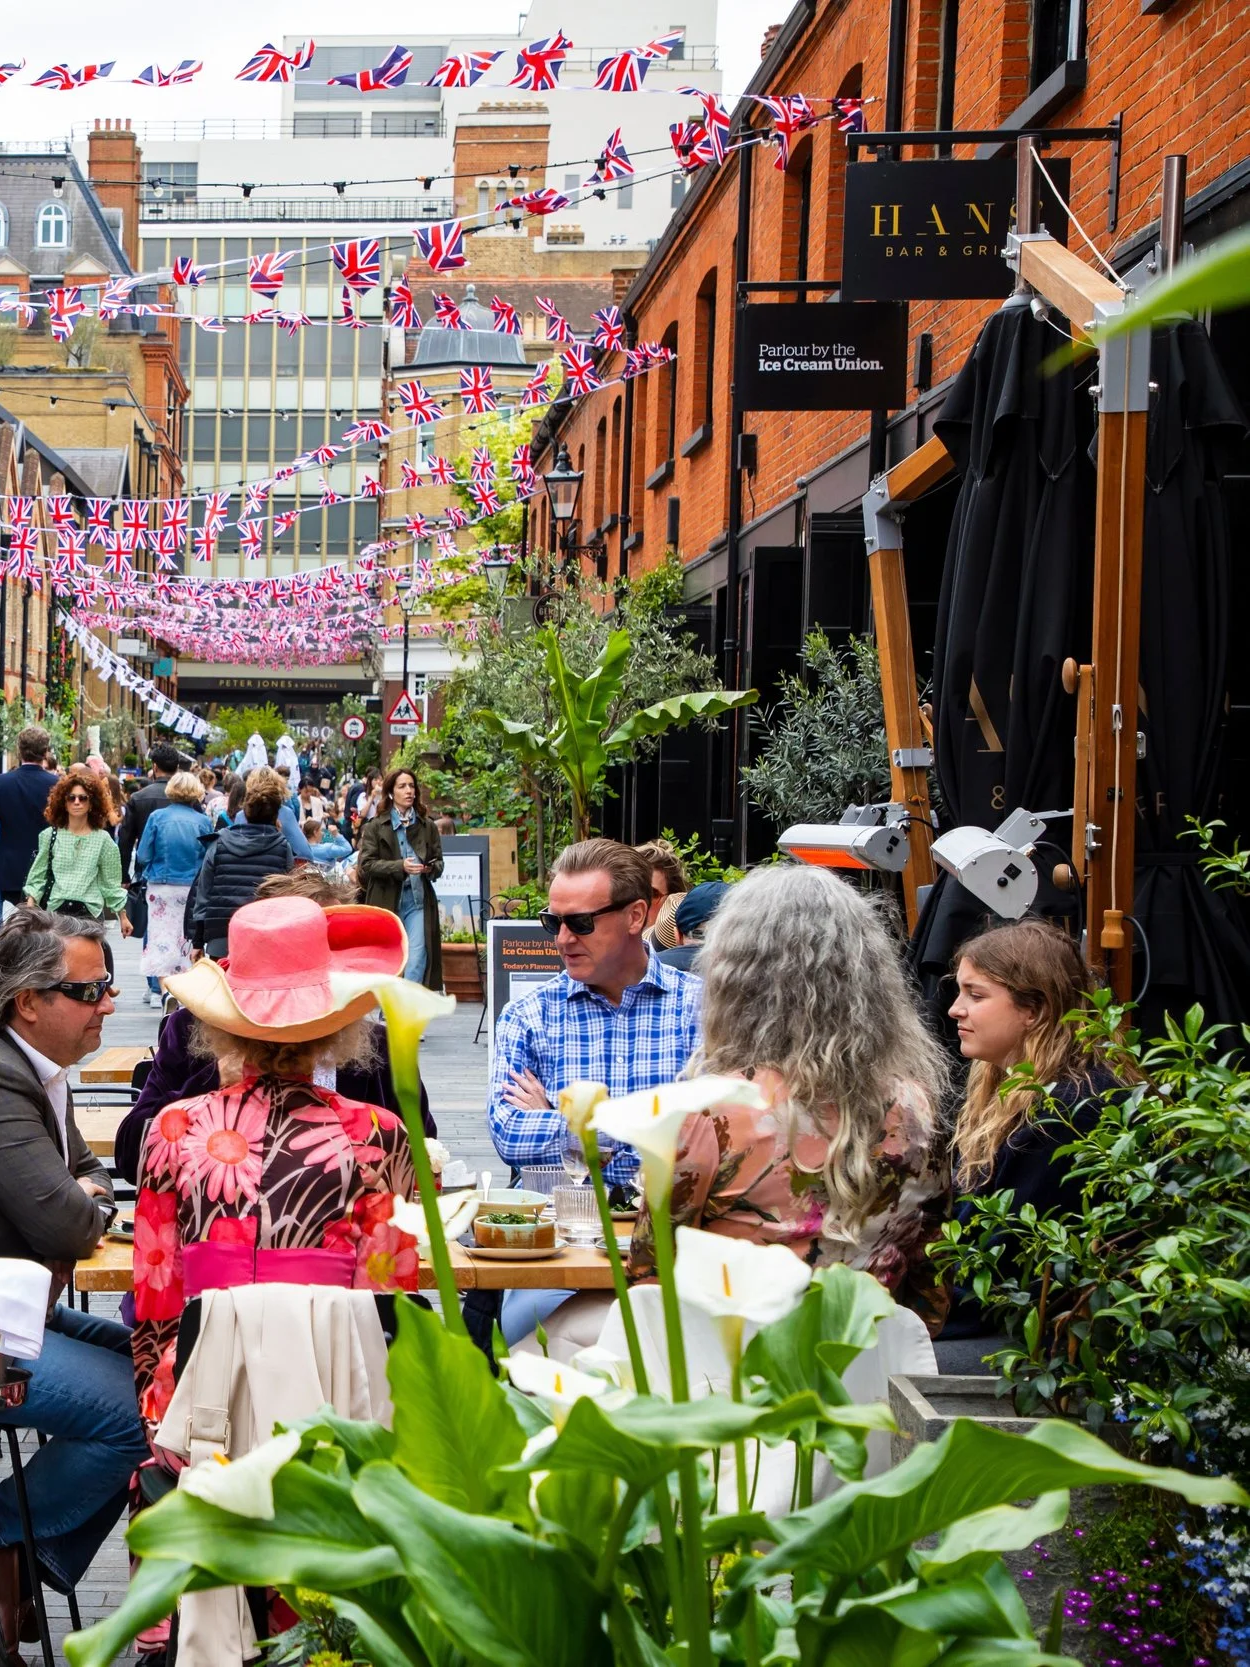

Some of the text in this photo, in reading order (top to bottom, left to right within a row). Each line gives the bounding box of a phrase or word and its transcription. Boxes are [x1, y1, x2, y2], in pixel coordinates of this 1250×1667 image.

[885, 246, 997, 257] BAR & GRI
[759, 343, 855, 358] Parlour by the
[758, 358, 884, 371] Ice Cream Union.
[219, 679, 252, 687] PETER
[257, 680, 292, 688] JONES
[532, 940, 543, 948] by
[502, 963, 529, 971] Today's
